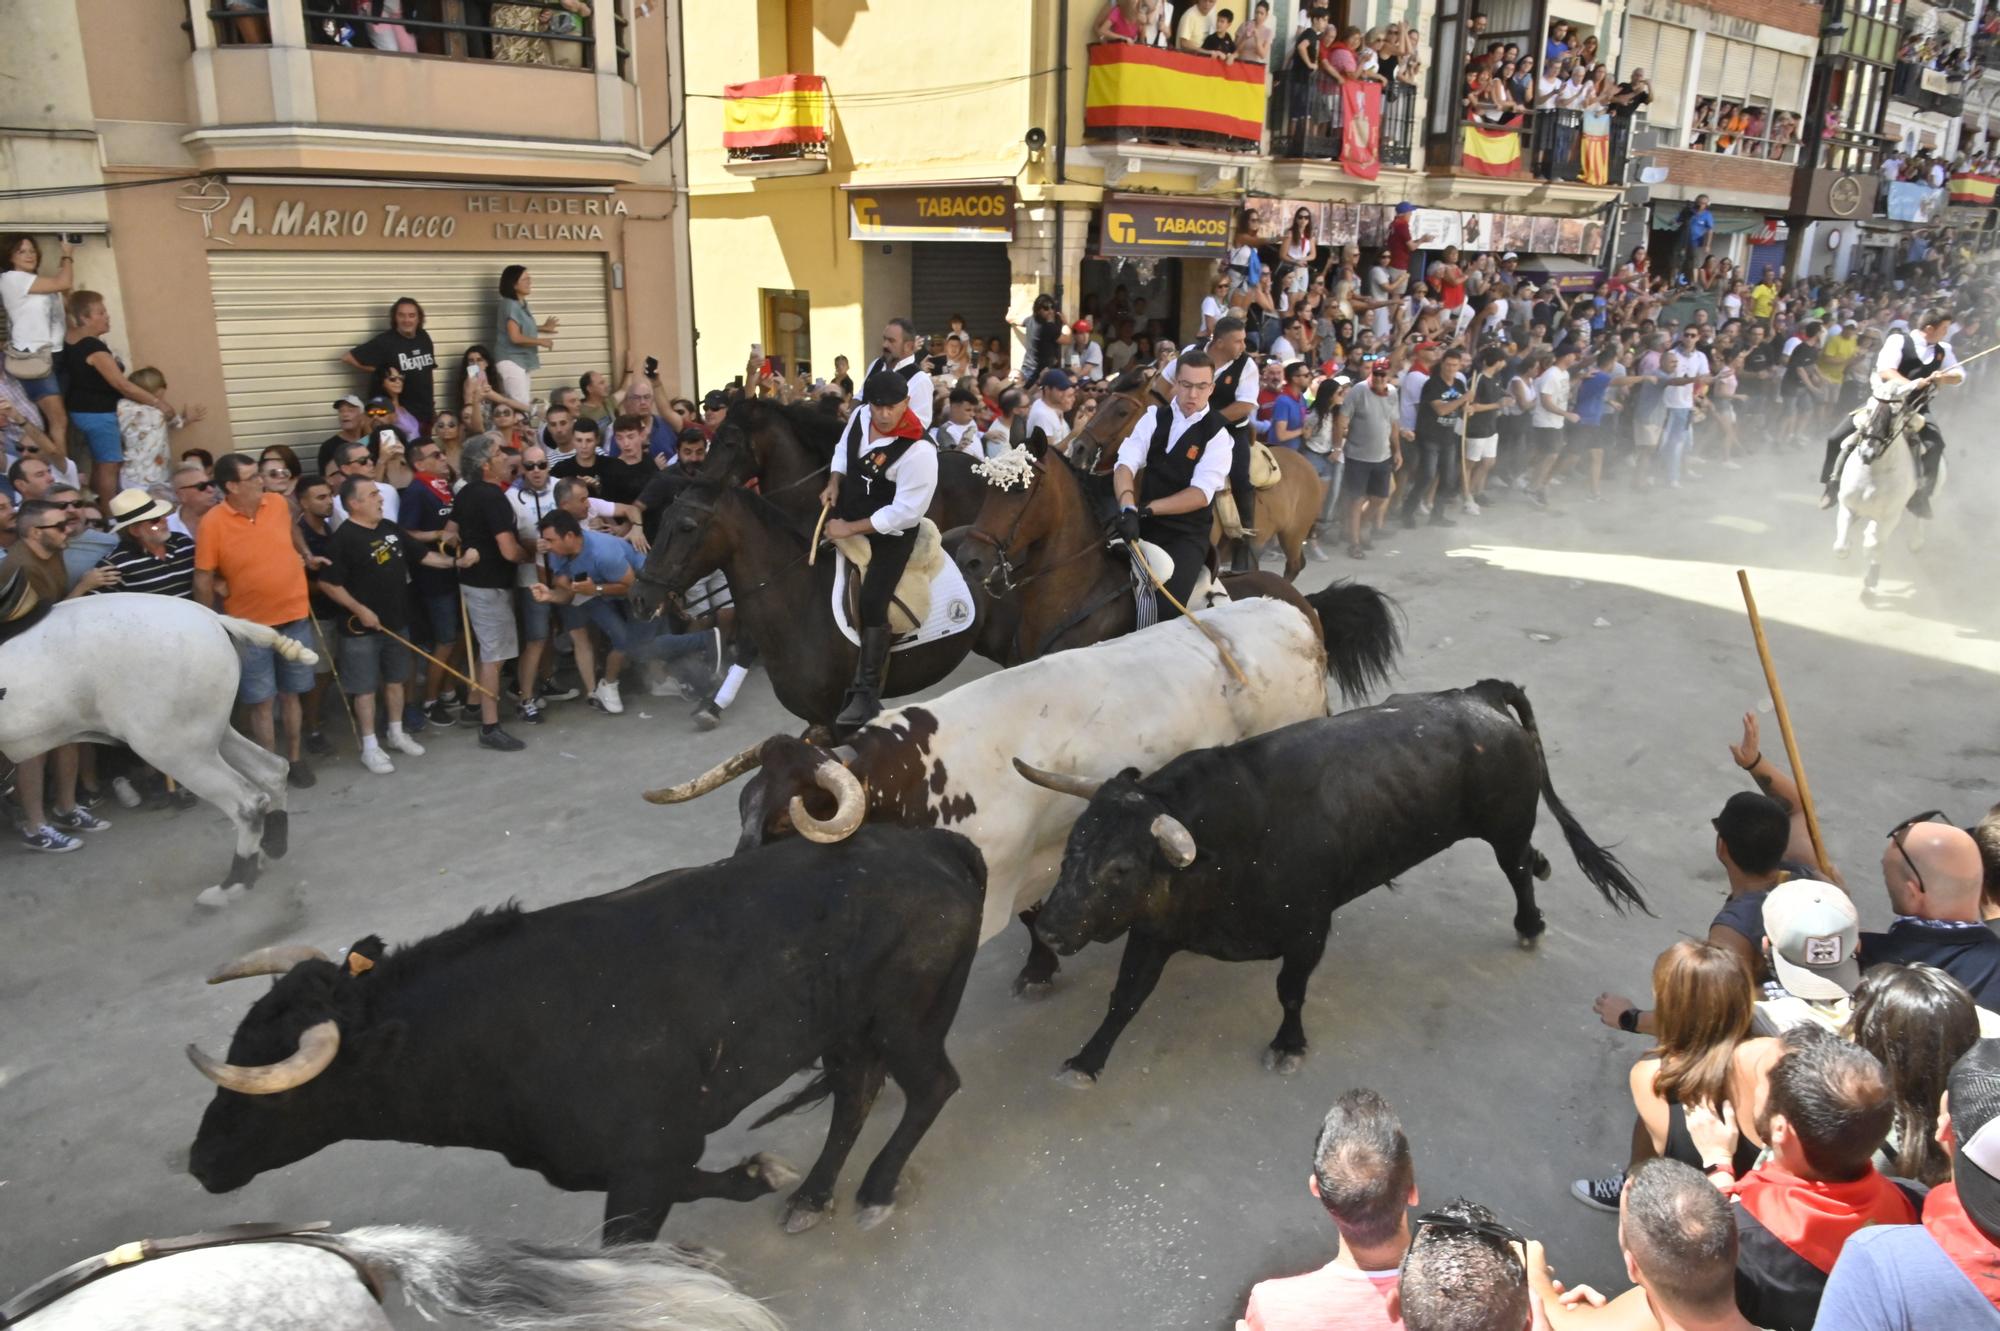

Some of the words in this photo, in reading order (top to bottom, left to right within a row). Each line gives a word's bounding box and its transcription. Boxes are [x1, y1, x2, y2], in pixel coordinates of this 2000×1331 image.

[467, 196, 629, 216] HELADERIA
[916, 195, 1007, 218] TABACOS
[230, 196, 264, 235] A.
[271, 200, 369, 238] MARIO
[383, 205, 457, 239] TACCO
[1154, 217, 1228, 236] TABACOS
[495, 222, 604, 241] ITALIANA
